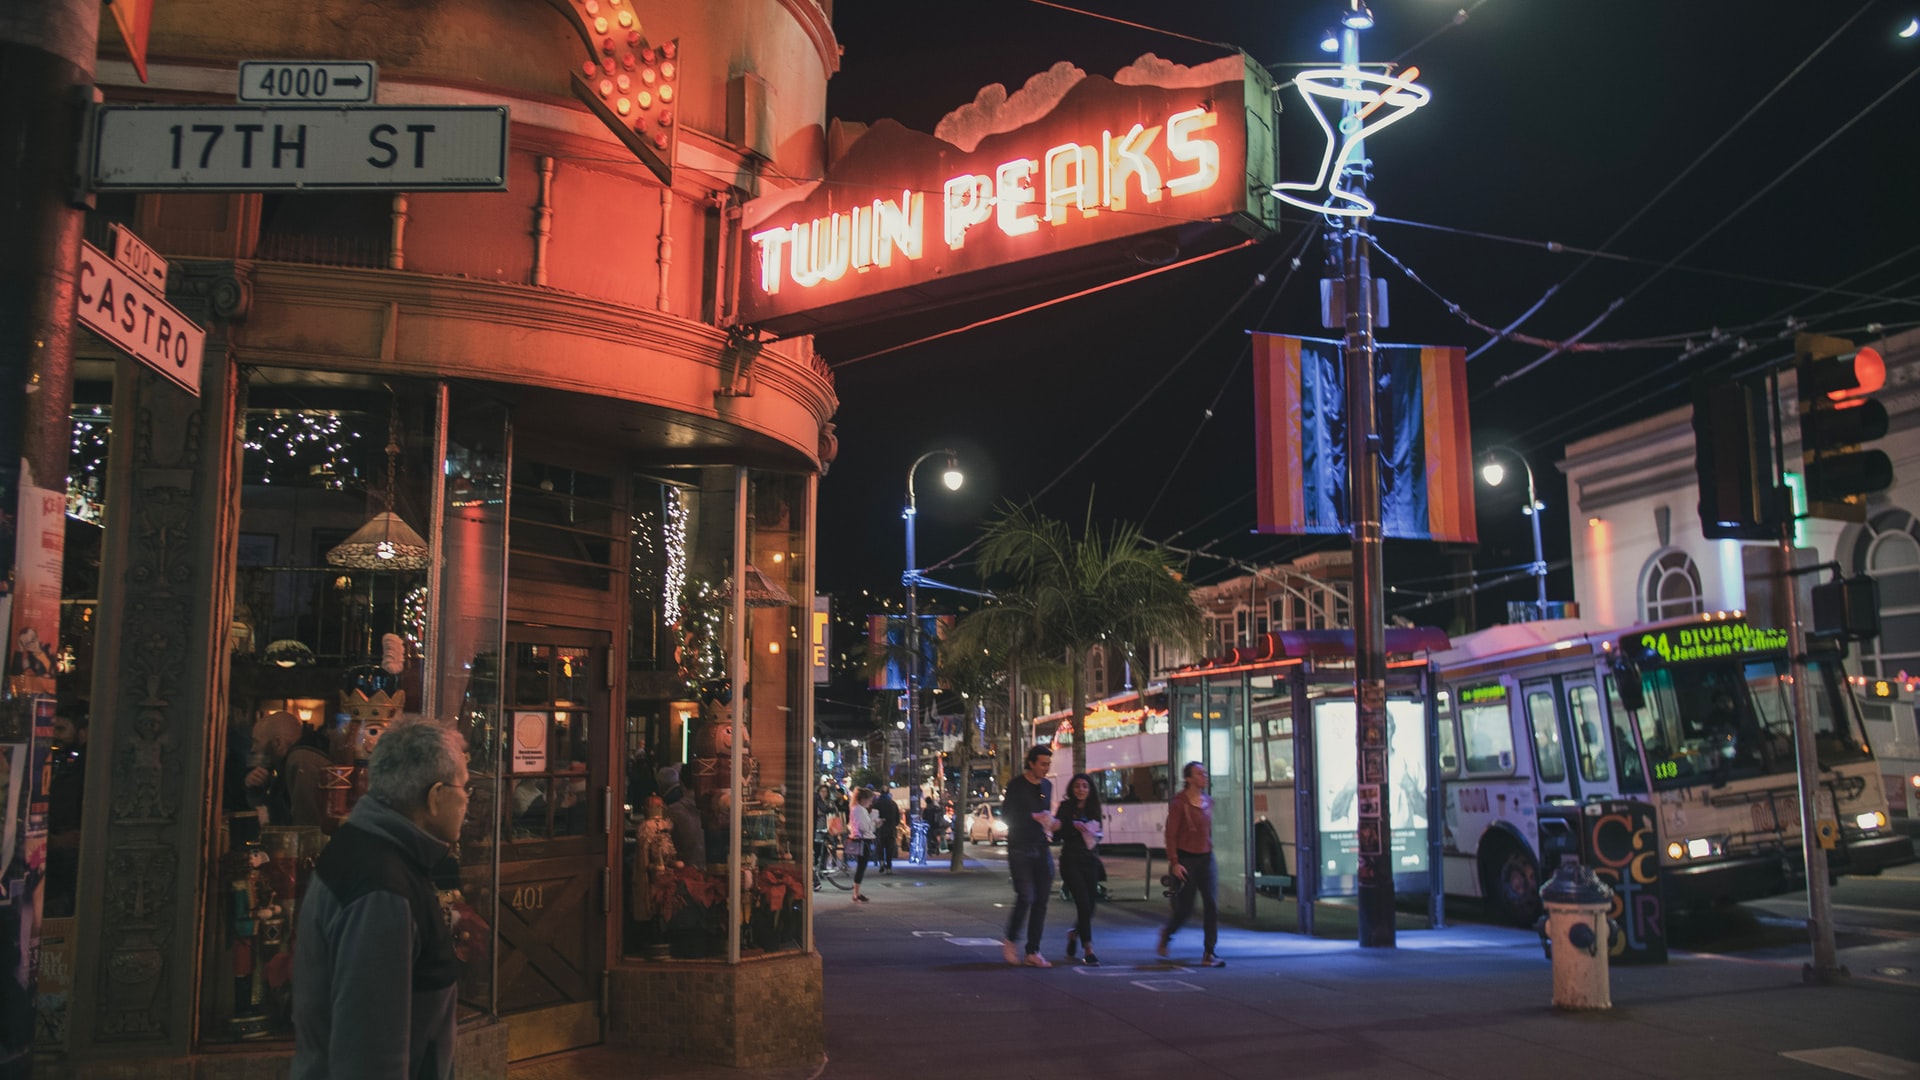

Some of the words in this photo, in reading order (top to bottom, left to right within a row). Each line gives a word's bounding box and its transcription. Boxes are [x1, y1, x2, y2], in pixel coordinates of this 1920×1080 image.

[260, 68, 328, 97] 4000
[169, 124, 307, 169] 17TH
[366, 123, 436, 169] ST
[752, 189, 924, 296] TWIN
[943, 107, 1221, 251] PEAKS
[123, 238, 150, 276] 400
[79, 260, 188, 369] CASTRO
[1641, 632, 1671, 662] 24
[511, 884, 545, 911] 401
